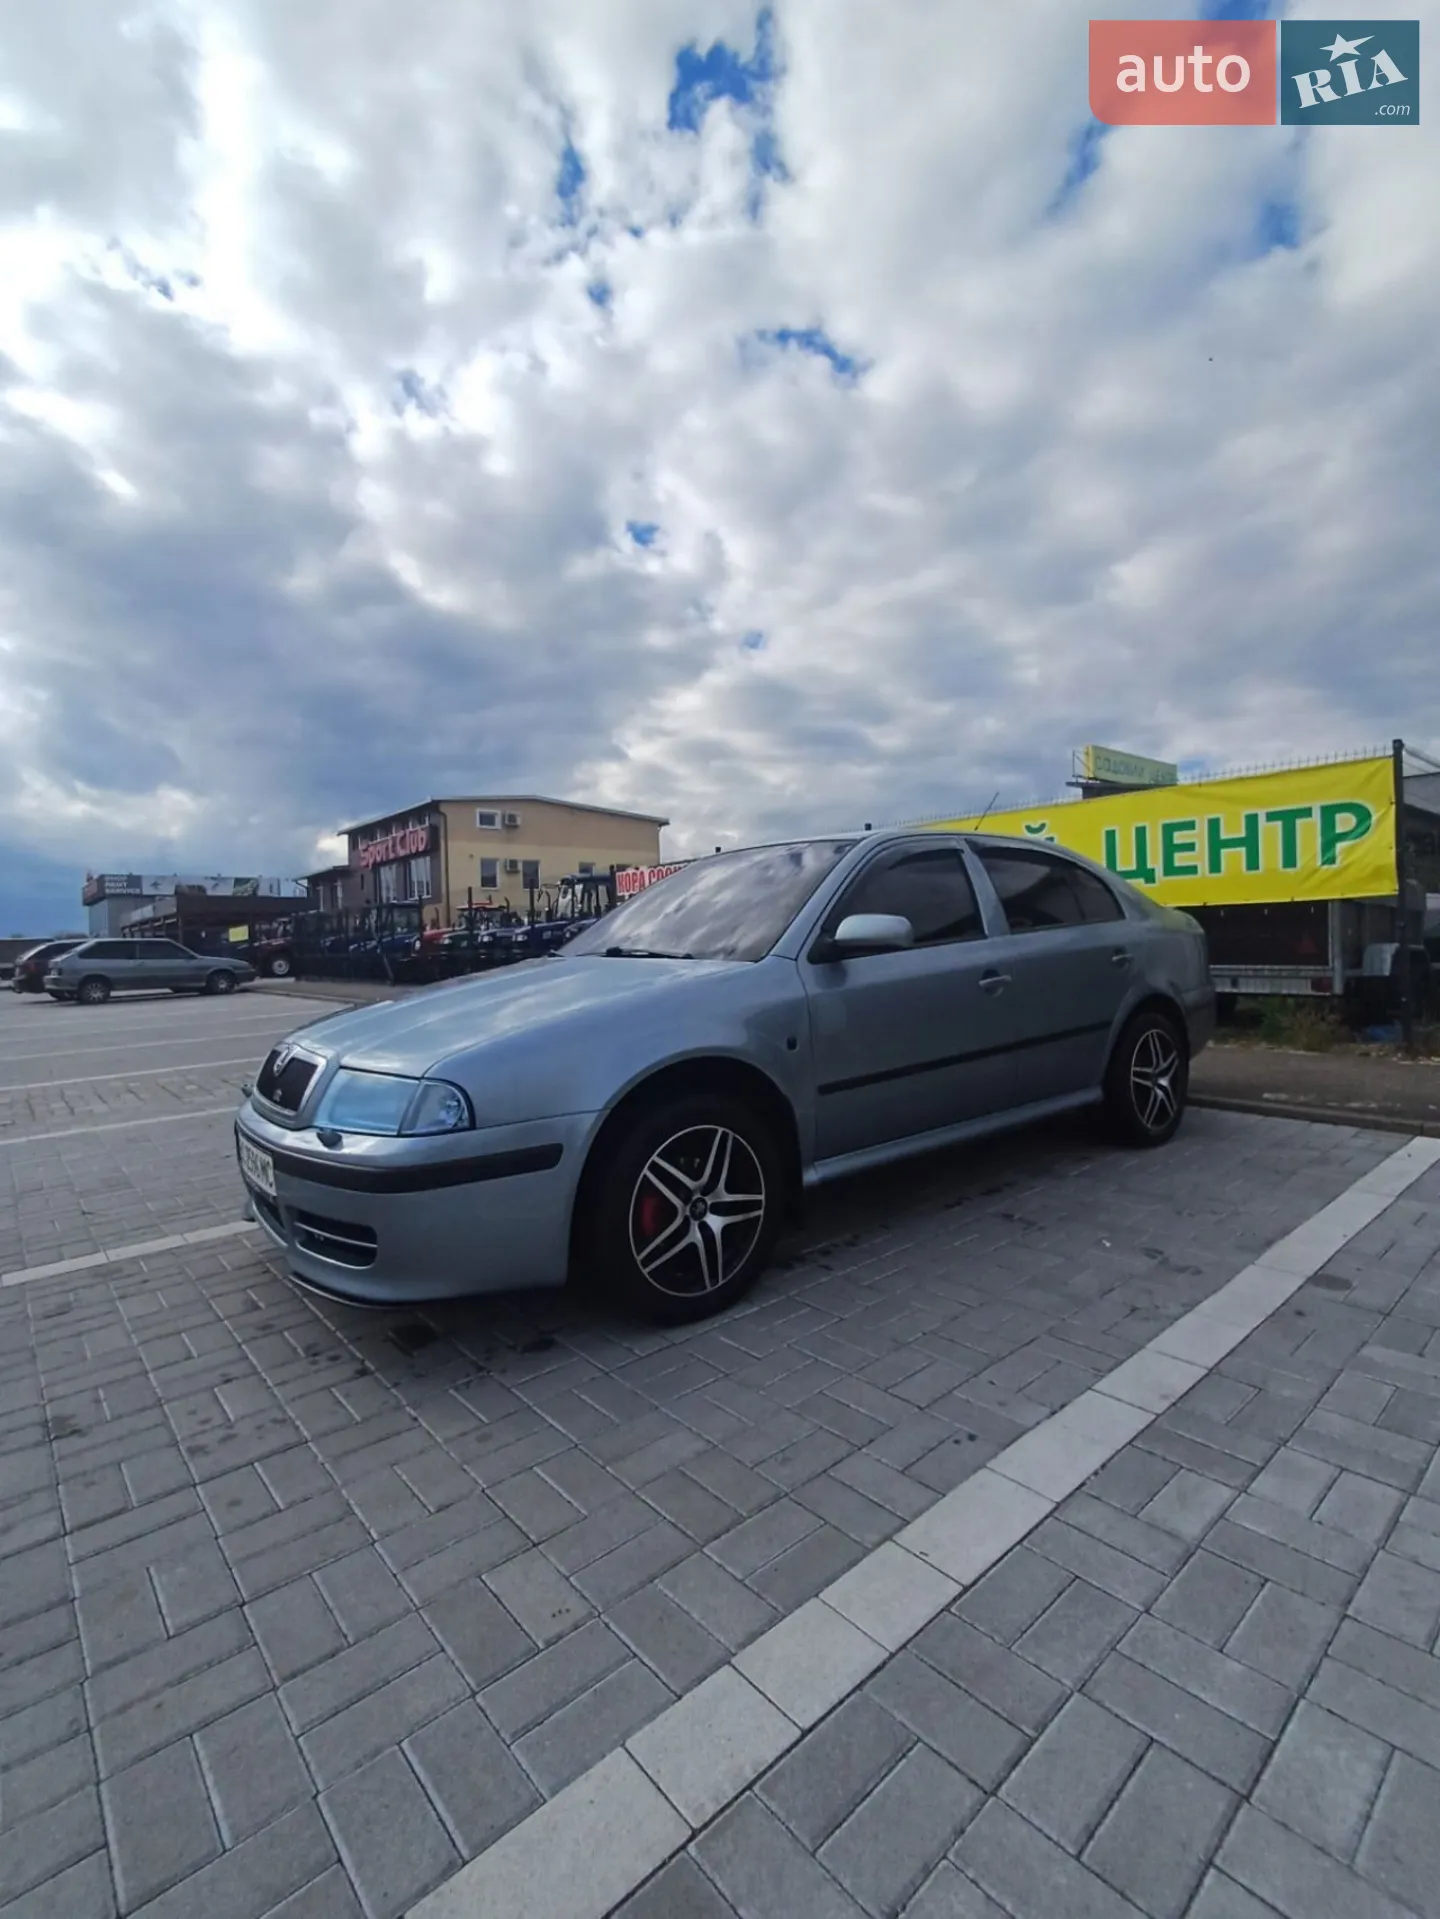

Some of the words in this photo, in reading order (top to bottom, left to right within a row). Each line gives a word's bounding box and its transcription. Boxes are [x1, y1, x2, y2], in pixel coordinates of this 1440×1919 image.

[360, 836, 395, 870] Sport
[396, 829, 427, 856] Club
[1105, 802, 1372, 884] ЦЕНТР
